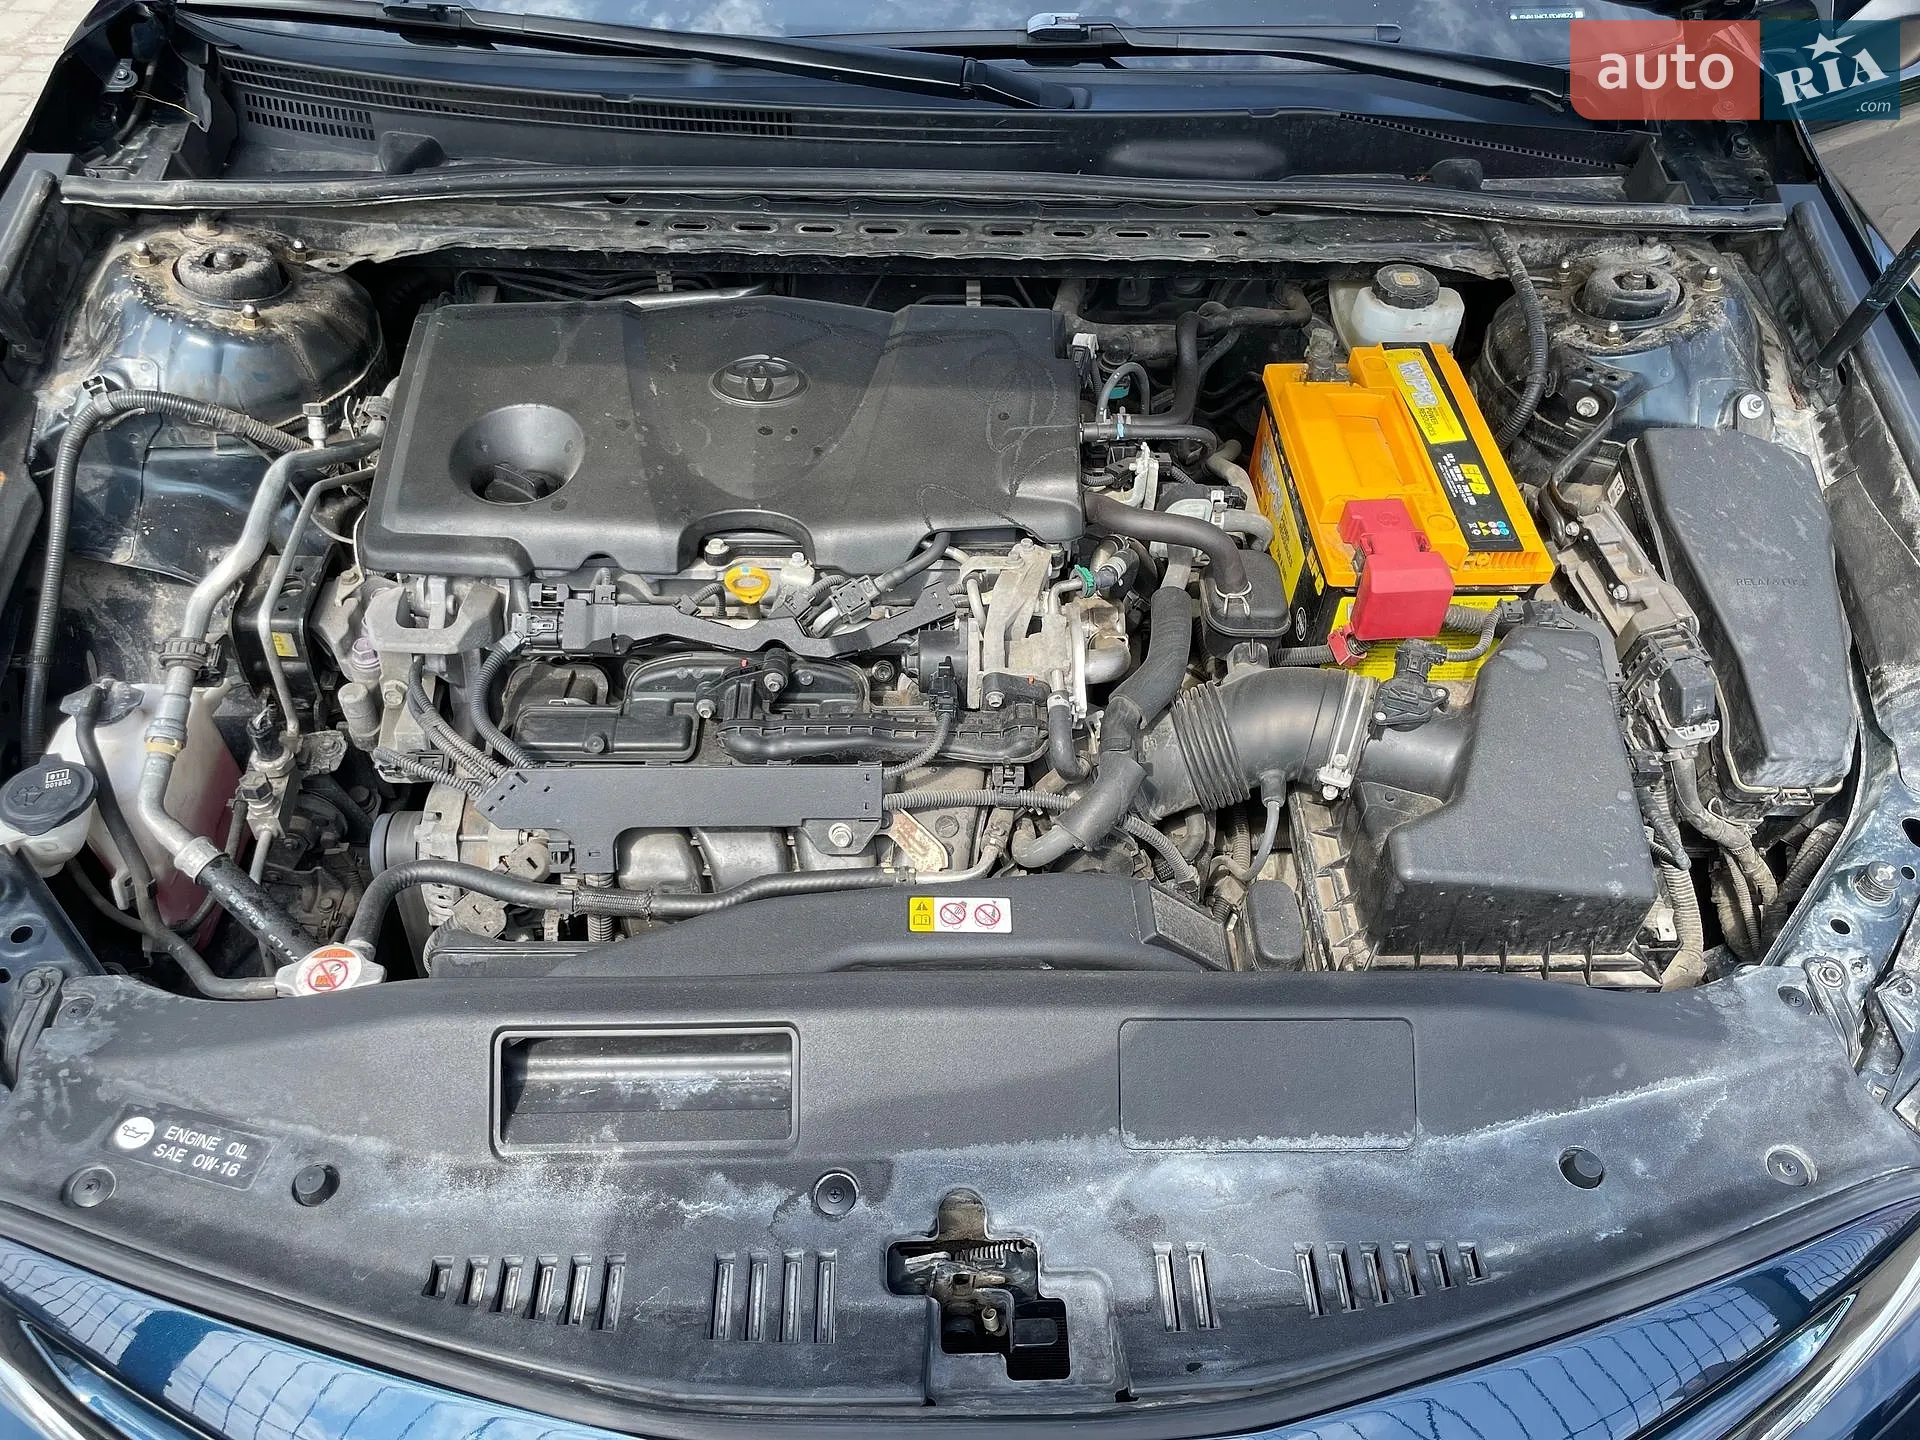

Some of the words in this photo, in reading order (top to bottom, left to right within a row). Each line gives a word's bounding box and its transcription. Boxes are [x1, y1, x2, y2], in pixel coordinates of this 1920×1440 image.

[163, 1125, 223, 1152] ENGINE
[226, 1142, 249, 1160] OIL
[153, 1143, 188, 1163] SAE
[192, 1153, 242, 1177] 0W-16
